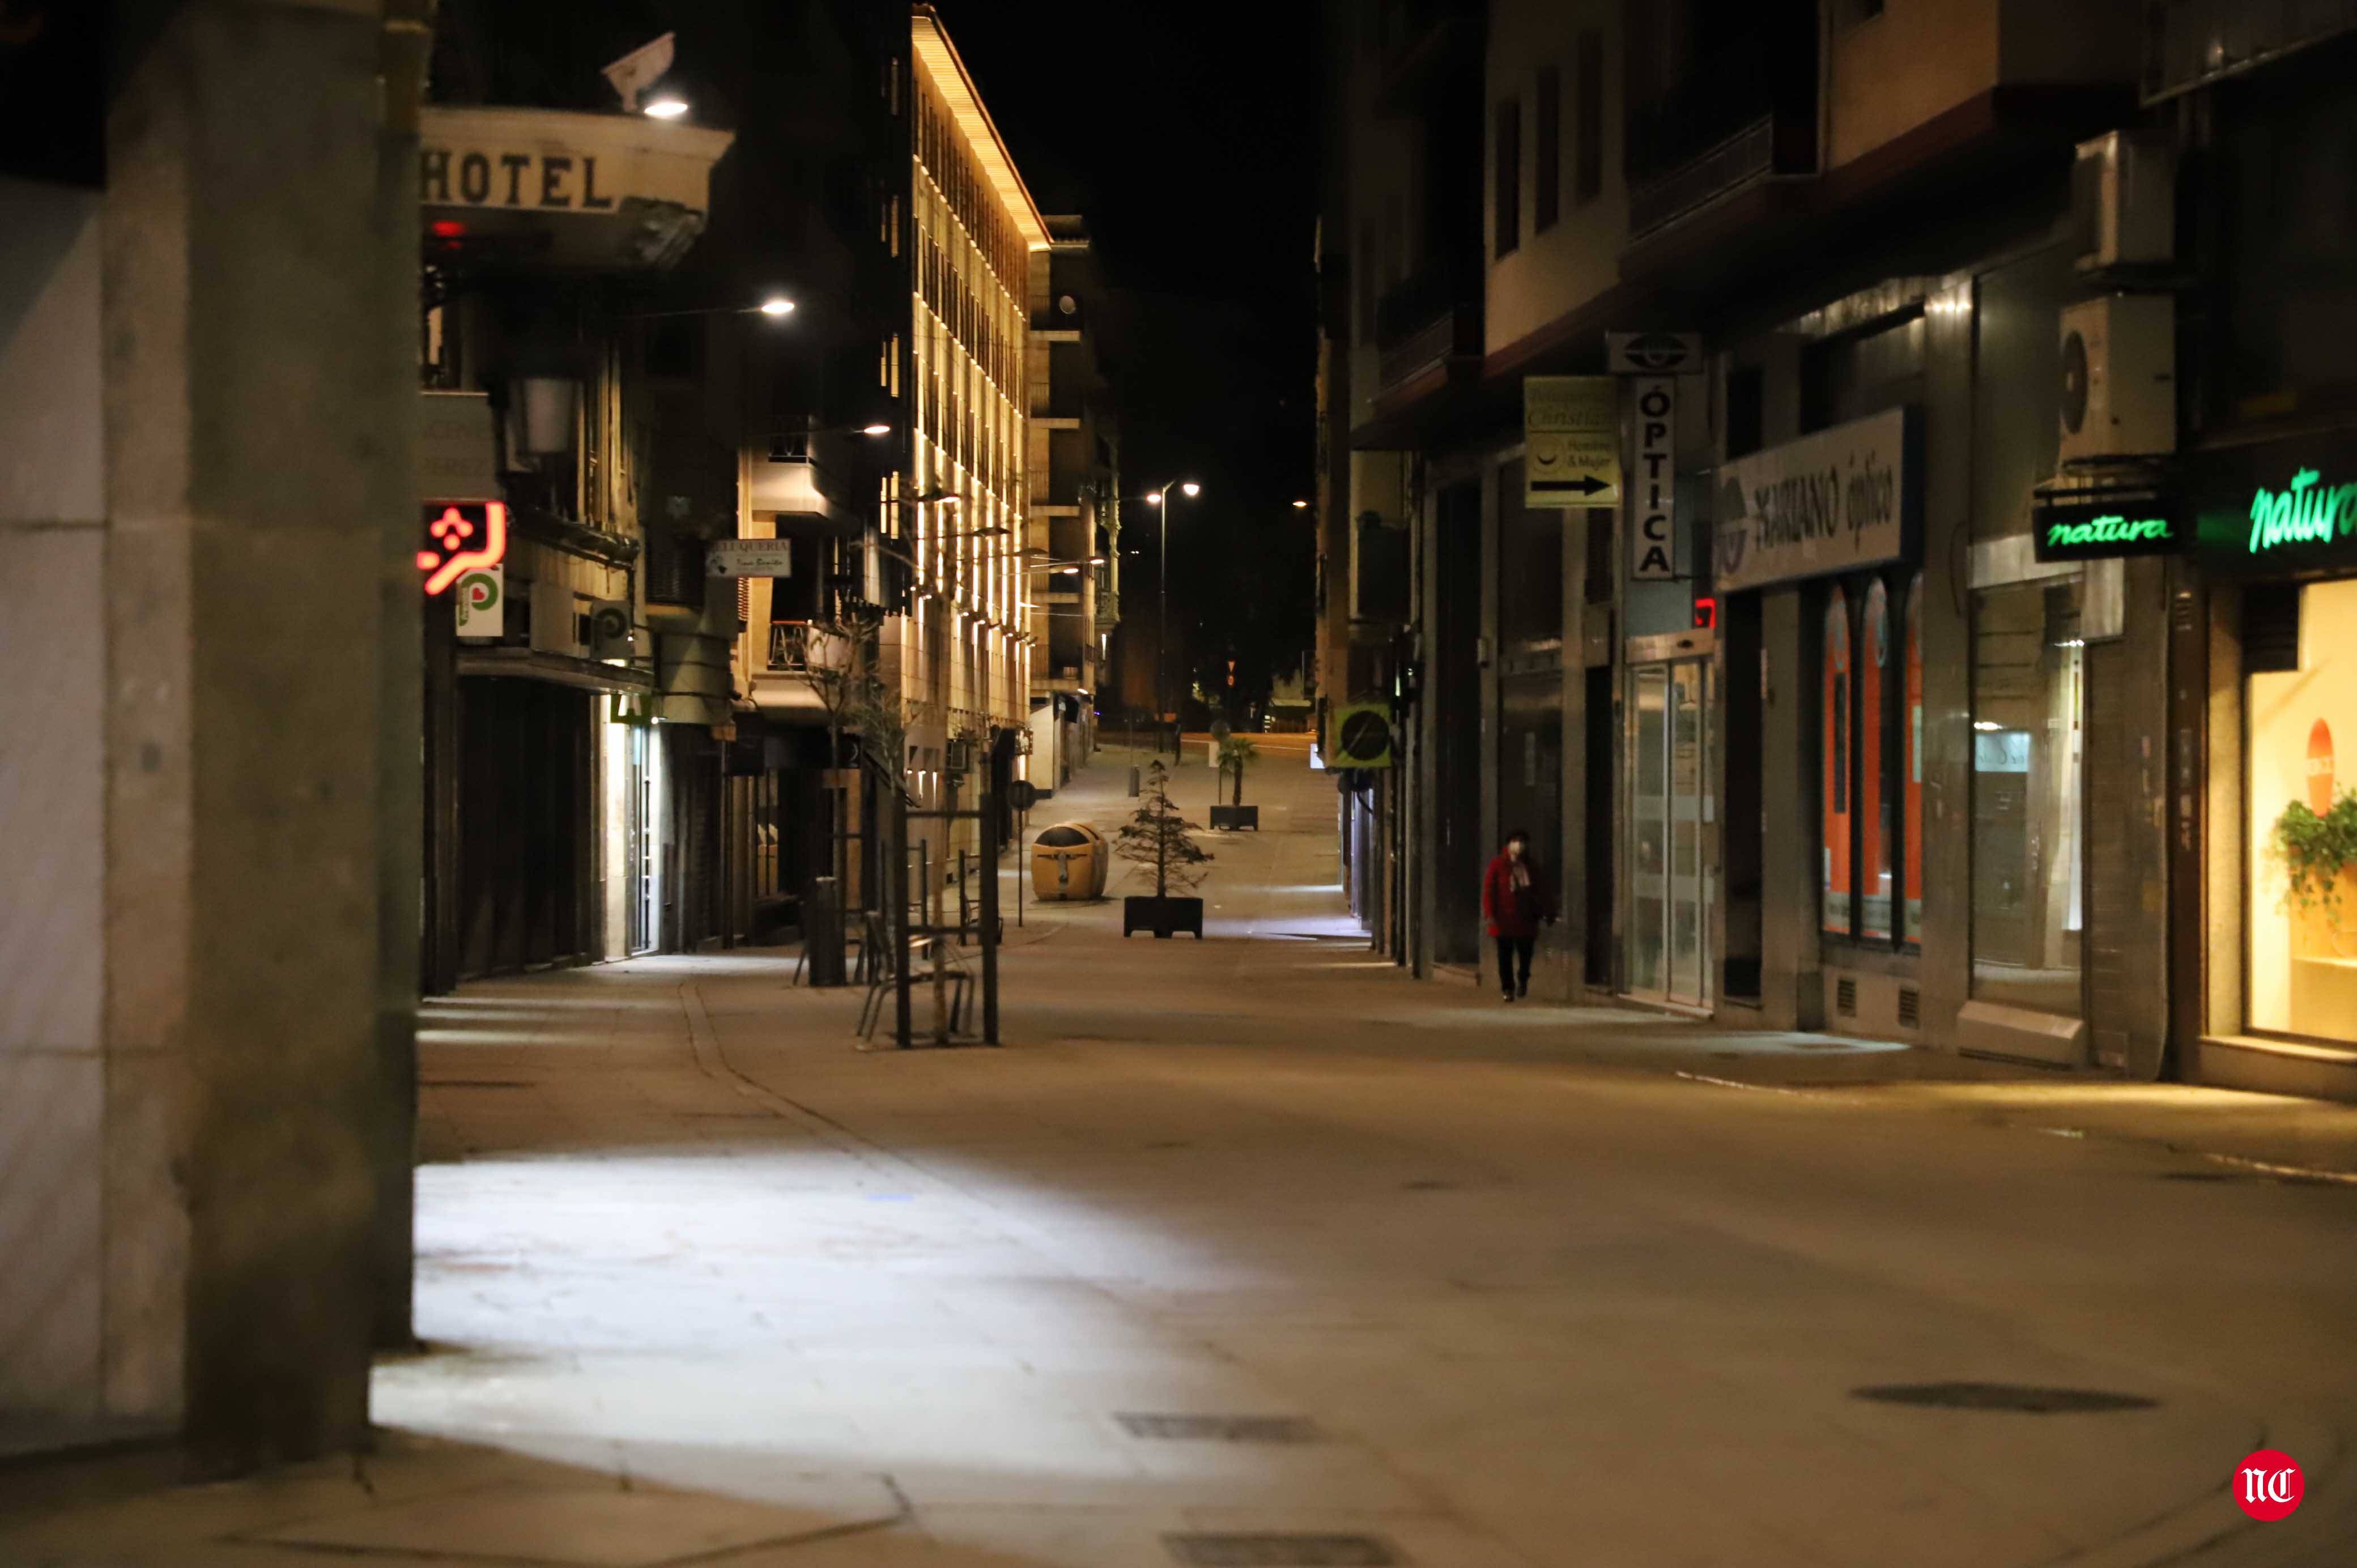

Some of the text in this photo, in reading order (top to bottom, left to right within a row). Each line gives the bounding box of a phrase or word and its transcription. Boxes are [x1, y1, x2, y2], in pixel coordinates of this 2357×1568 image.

[420, 149, 613, 208] HOTEL
[1639, 384, 1671, 573] ÓPTICA
[2047, 514, 2175, 547] natura
